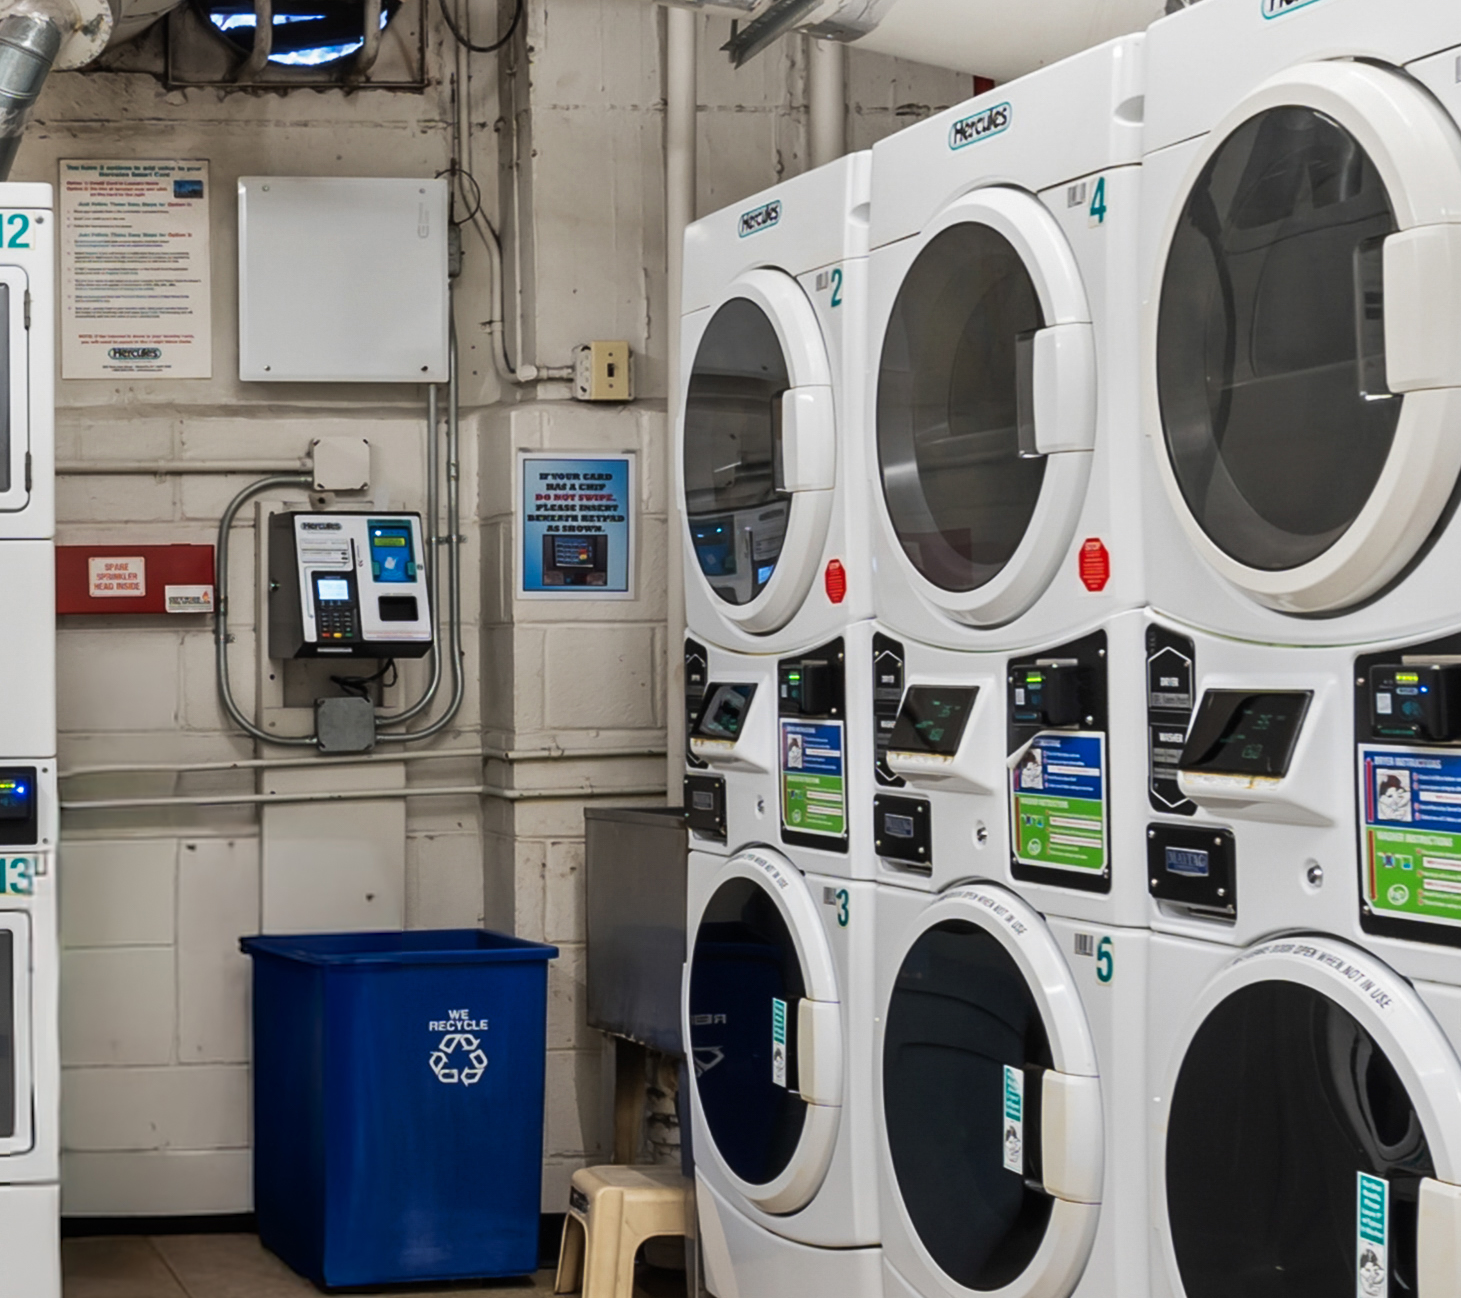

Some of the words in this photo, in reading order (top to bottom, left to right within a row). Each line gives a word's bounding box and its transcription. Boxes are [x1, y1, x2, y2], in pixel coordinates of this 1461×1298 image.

[952, 104, 1008, 145] Hercules
[741, 202, 780, 233] Hercules
[1089, 177, 1107, 224] 4
[830, 268, 843, 307] 2
[104, 563, 129, 571] SPARE
[836, 889, 849, 927] 3
[1096, 936, 1114, 983] 5
[1341, 965, 1365, 983] NOT
[1360, 977, 1375, 992] IN
[1370, 988, 1393, 1009] USE
[429, 1019, 489, 1031] RECYCLE
[448, 1009, 469, 1020] WE
